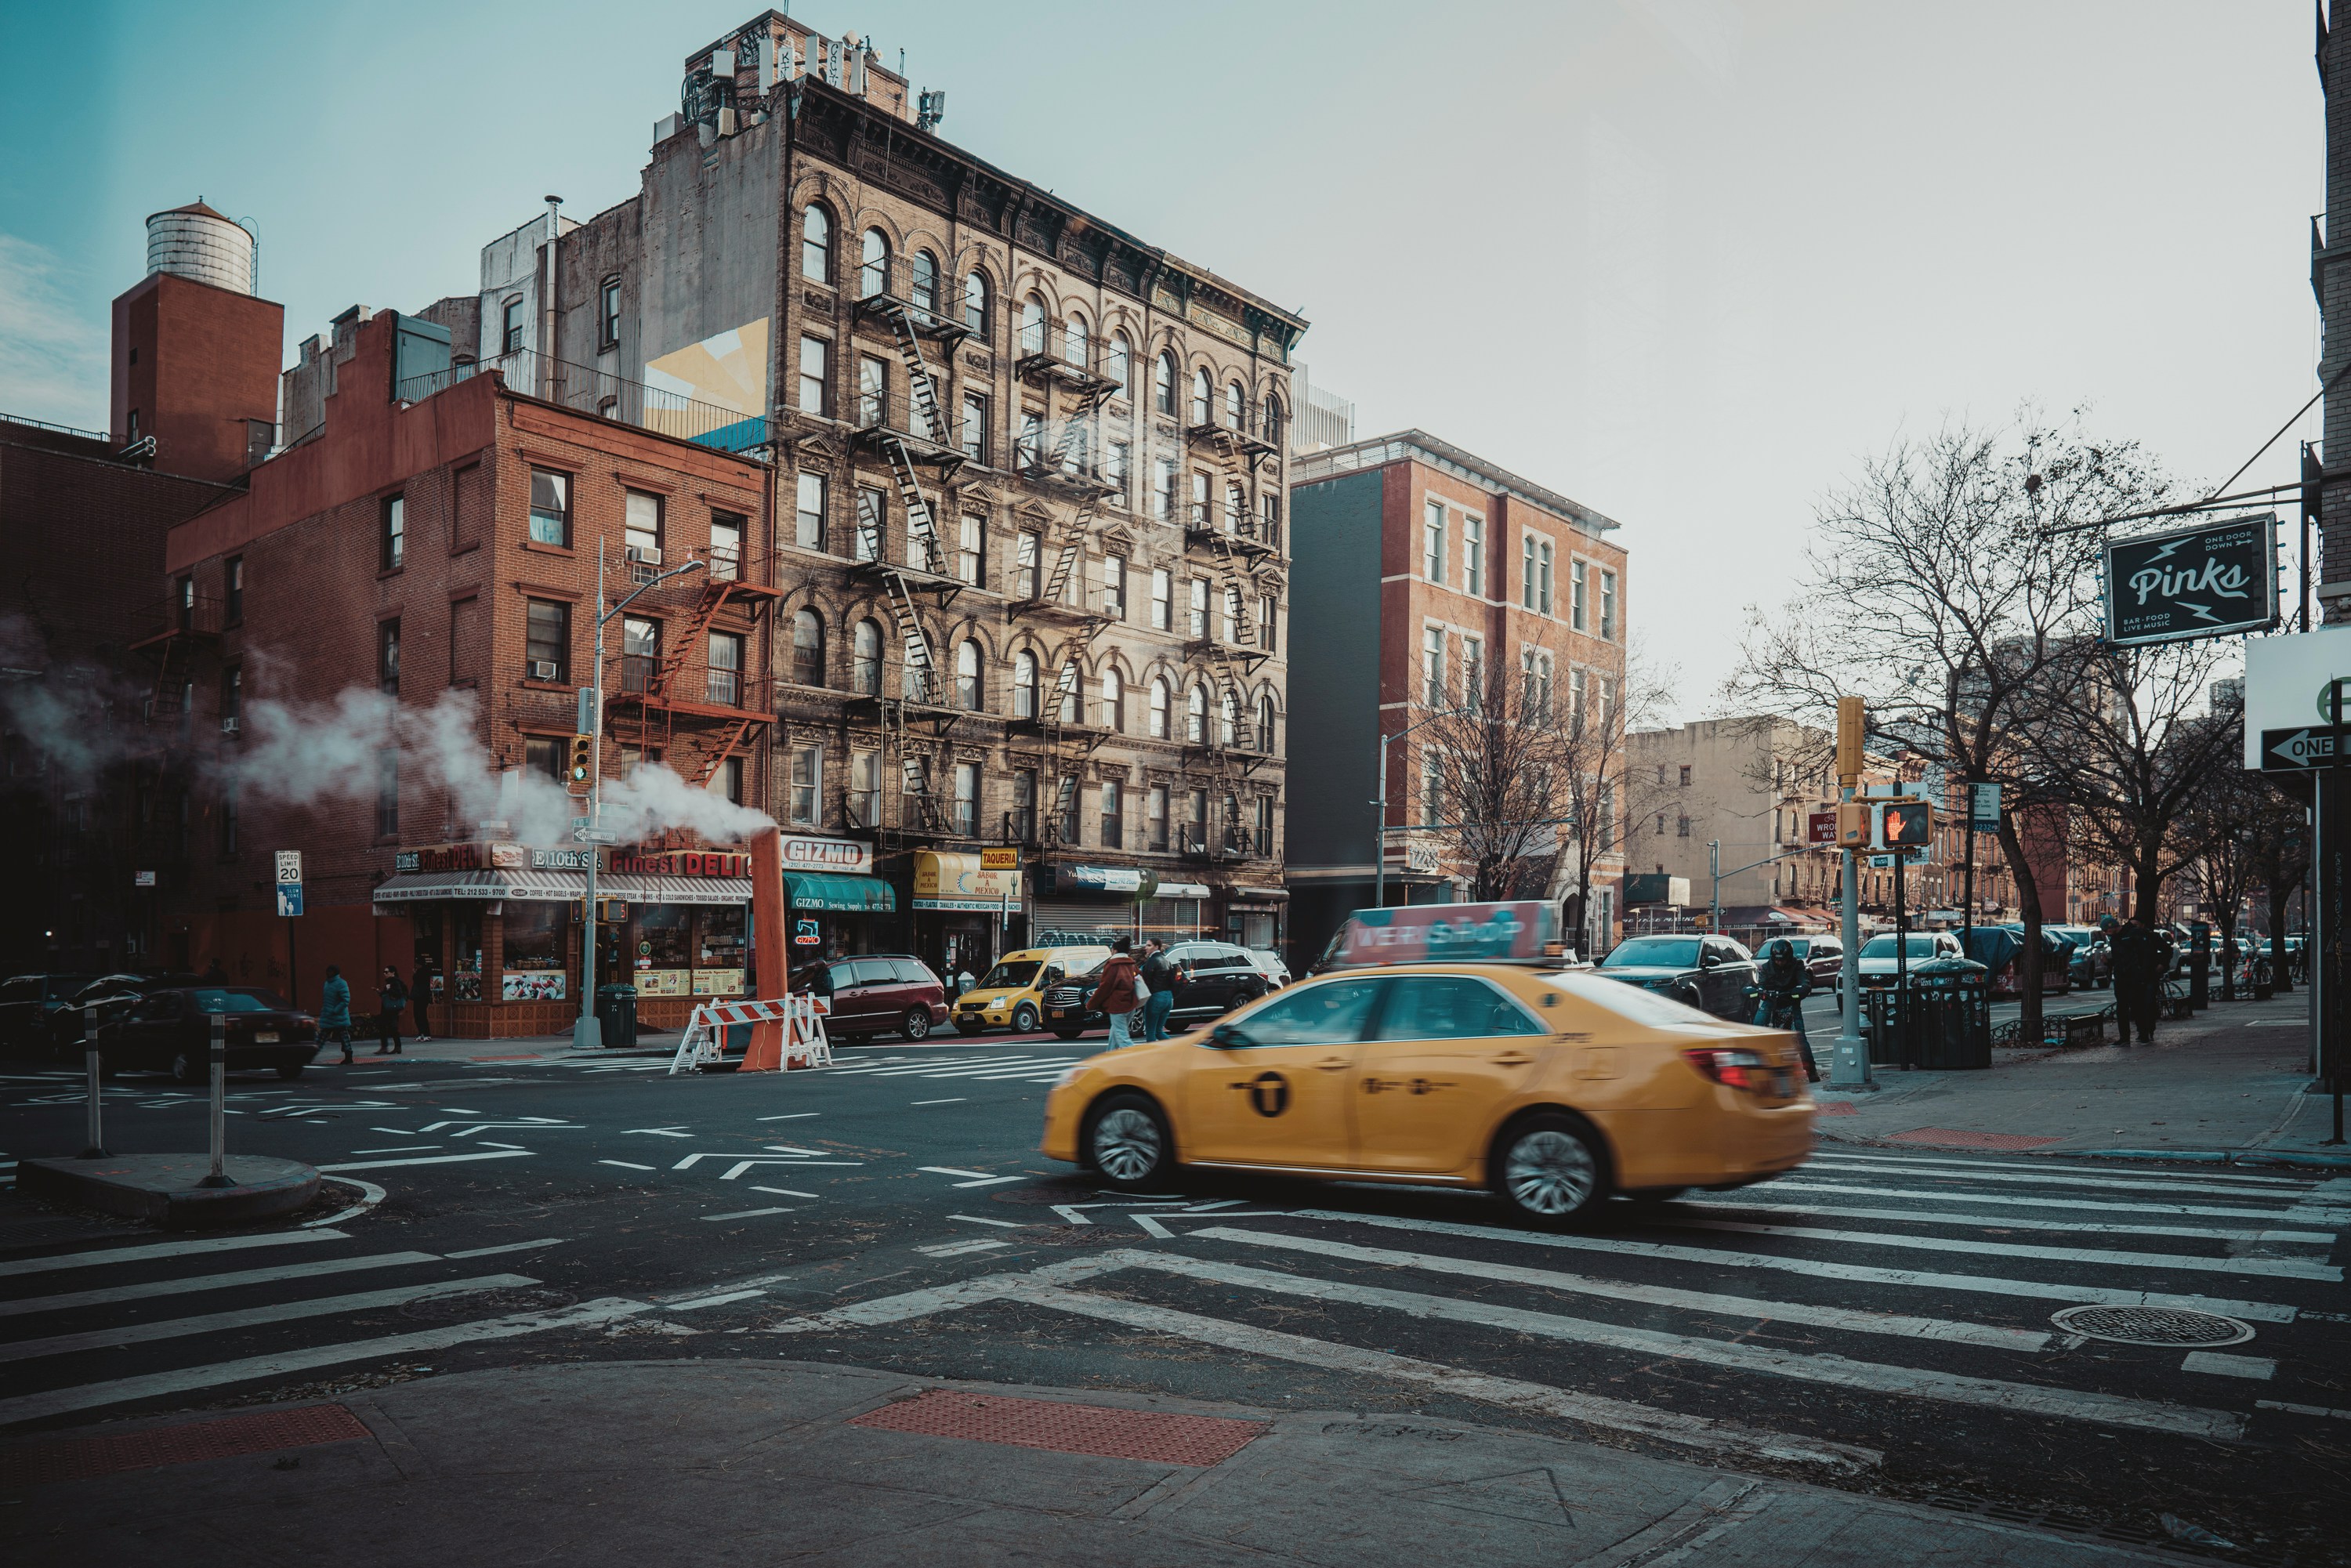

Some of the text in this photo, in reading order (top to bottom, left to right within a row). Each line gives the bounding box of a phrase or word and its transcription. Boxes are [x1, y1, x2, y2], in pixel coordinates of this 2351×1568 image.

[2204, 531, 2251, 544] ONE DOOR
[2205, 541, 2233, 552] DOWN
[2128, 556, 2251, 606] Pinks
[2146, 613, 2171, 621] FOOD
[2143, 620, 2170, 629] MUSIC
[2291, 737, 2333, 757] ONE
[1817, 823, 1837, 831] WRO
[422, 845, 479, 871] Finest DELI
[534, 851, 545, 865] E
[550, 850, 578, 867] 10th
[788, 841, 859, 864] GIZMO
[983, 853, 1016, 864] TAQUERIA
[611, 852, 678, 873] Finest
[685, 853, 741, 876] DELI
[281, 868, 298, 879] 20
[795, 898, 824, 908] GIZMO
[829, 902, 845, 911] Sewing
[848, 903, 861, 911] Supply
[621, 904, 626, 918] 5
